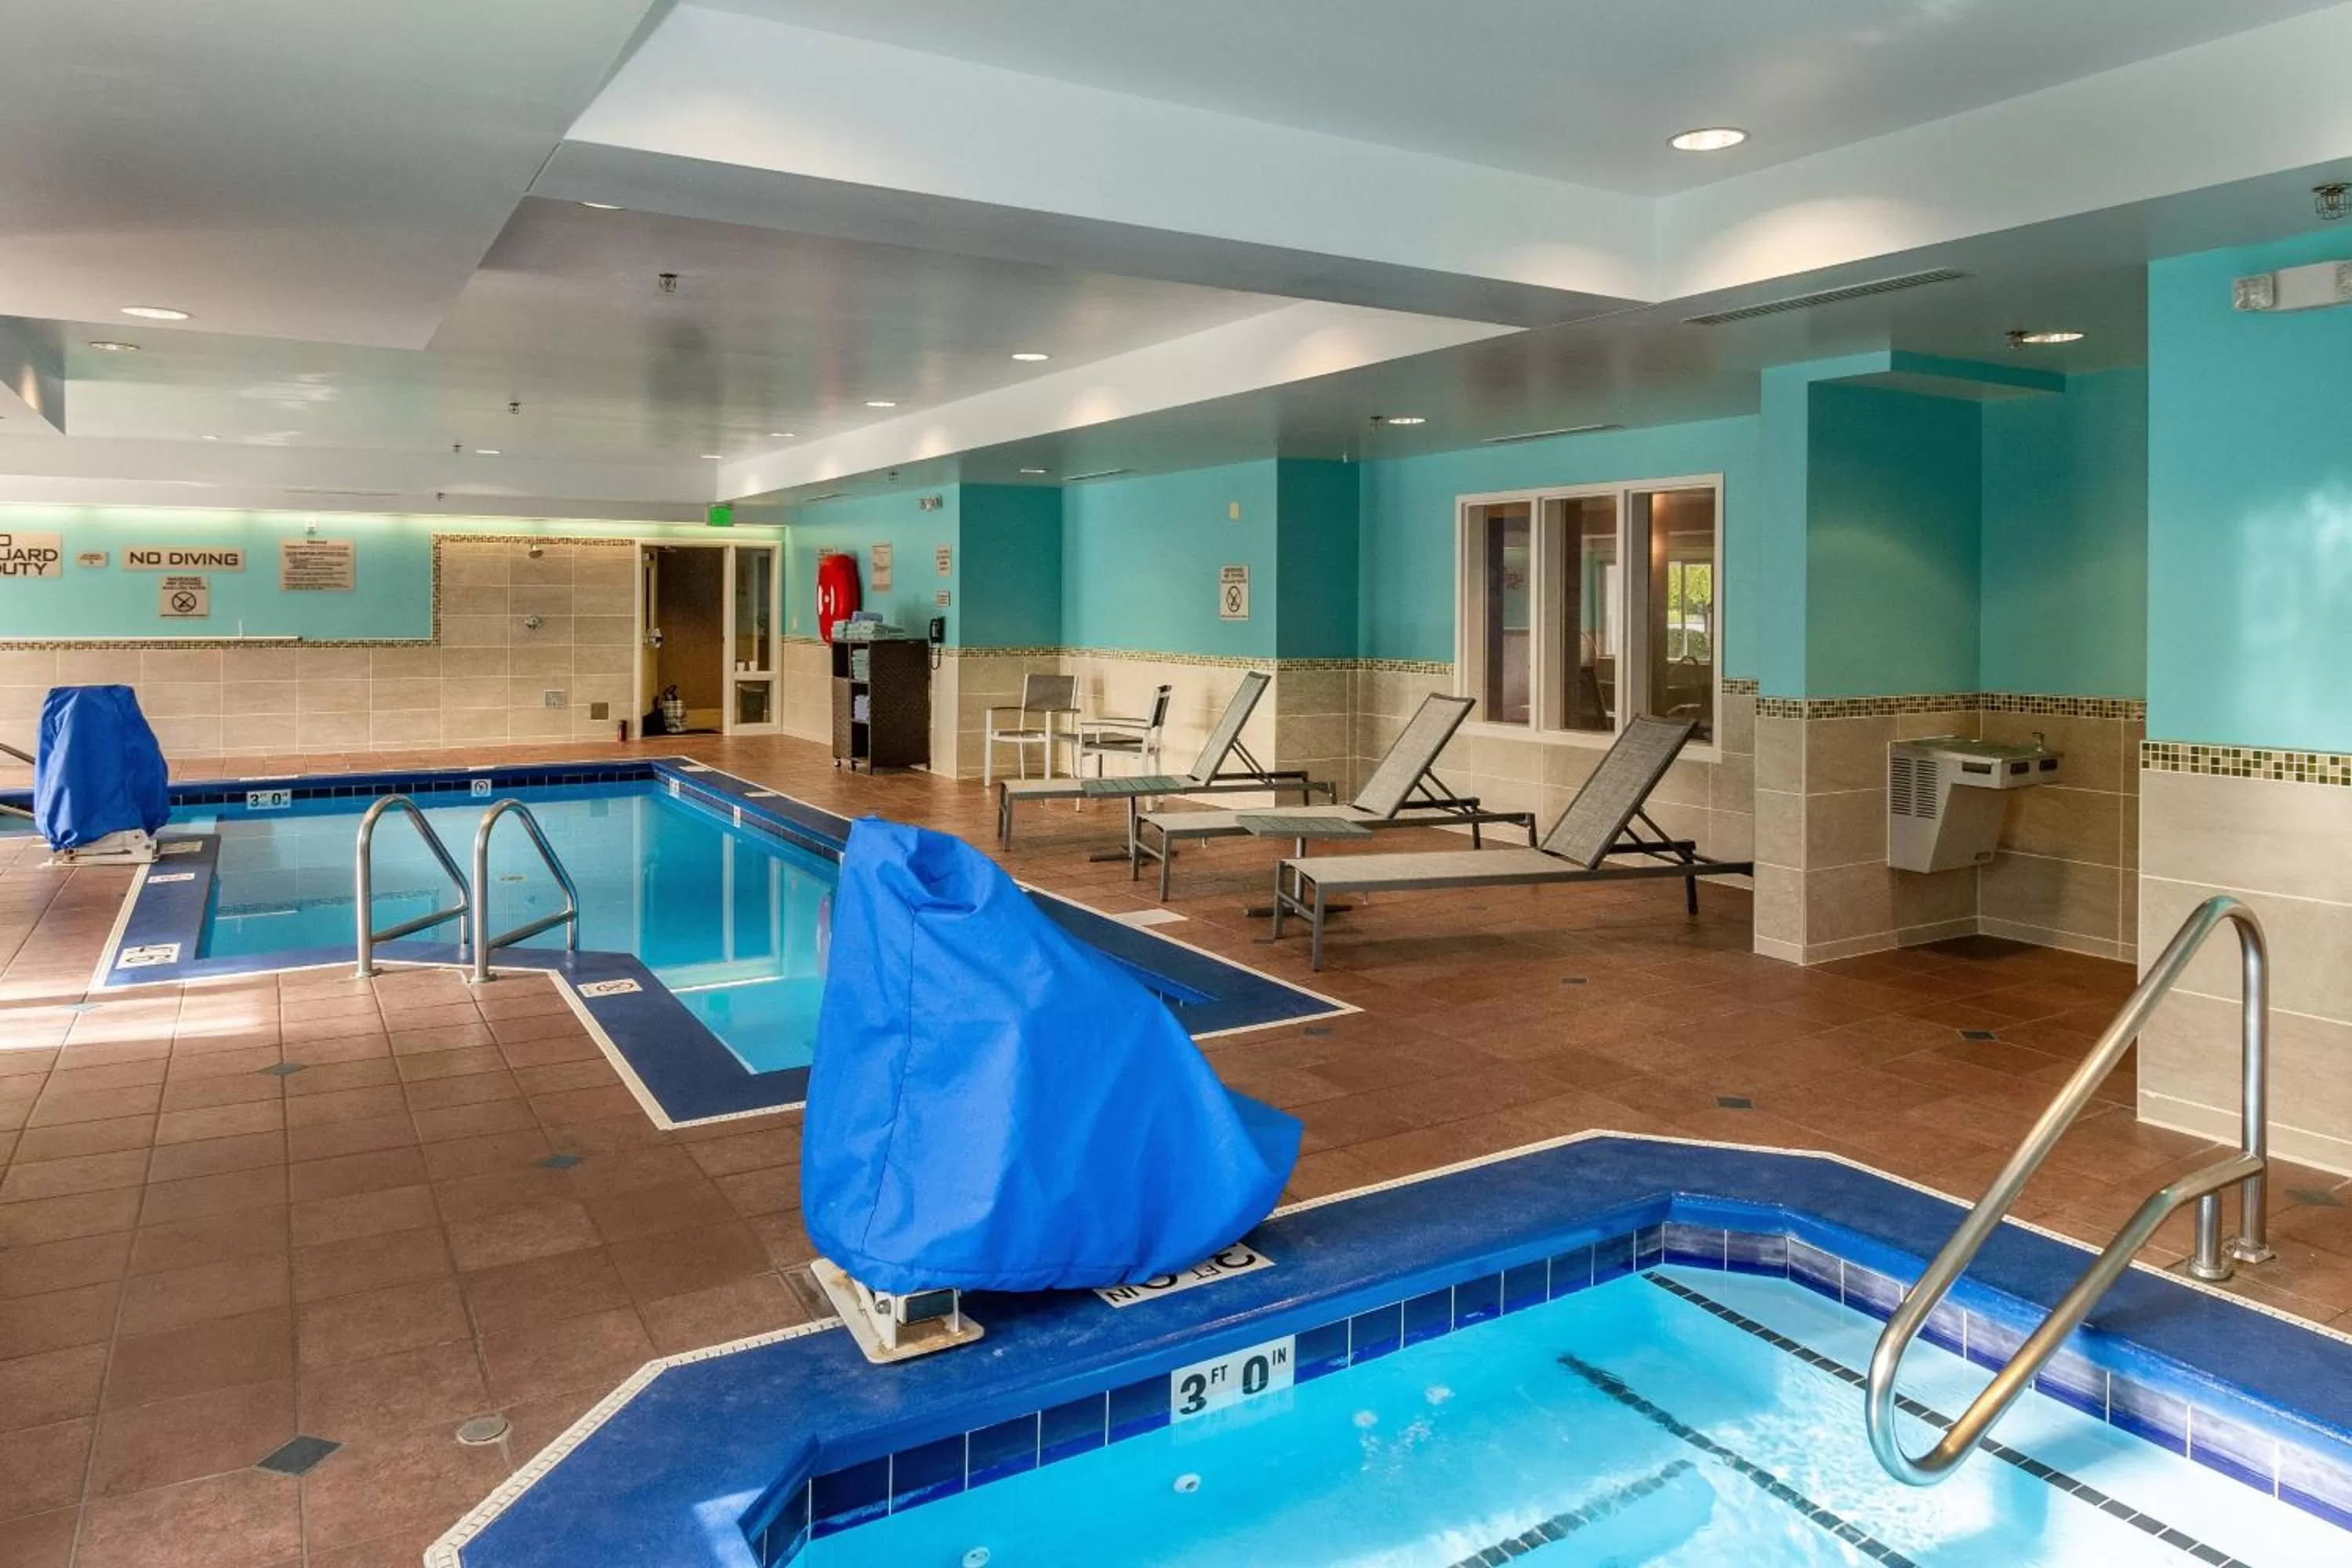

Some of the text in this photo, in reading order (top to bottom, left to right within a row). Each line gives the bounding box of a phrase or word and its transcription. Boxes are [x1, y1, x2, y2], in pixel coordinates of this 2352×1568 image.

[129, 551, 238, 565] NO DIVING
[0, 562, 48, 575] UTY
[1179, 1347, 1287, 1414] 3 FT 0 IN
